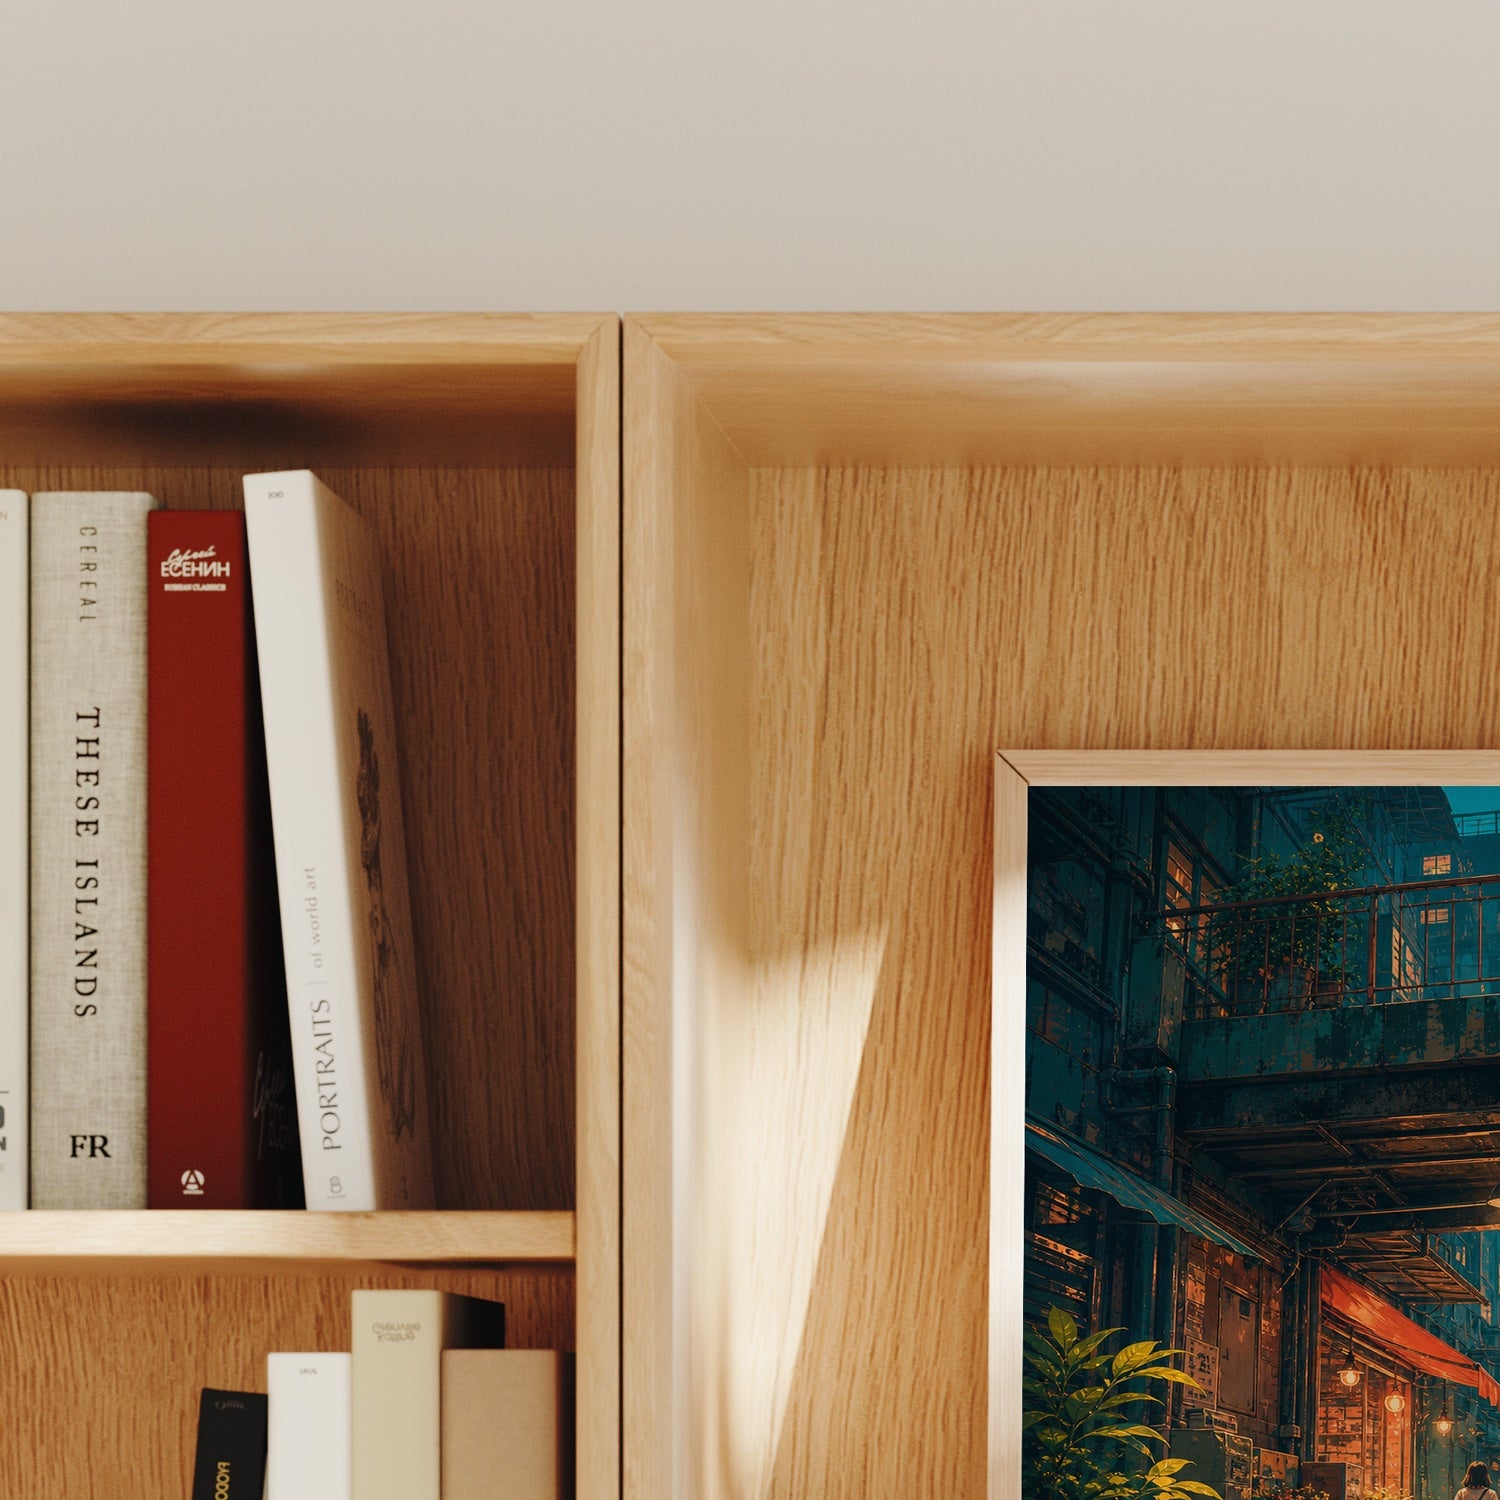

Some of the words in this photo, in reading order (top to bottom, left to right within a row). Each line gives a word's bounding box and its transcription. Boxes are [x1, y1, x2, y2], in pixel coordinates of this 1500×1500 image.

[79, 526, 97, 623] CEREAL
[160, 561, 231, 577] ЕСЕНИН
[75, 707, 100, 838] THESE
[304, 866, 316, 889] art
[74, 859, 98, 1018] ISLANDS
[307, 896, 322, 944] world
[311, 950, 324, 969] of
[310, 998, 342, 1152] PORTRAITS
[69, 1135, 111, 1159] FR
